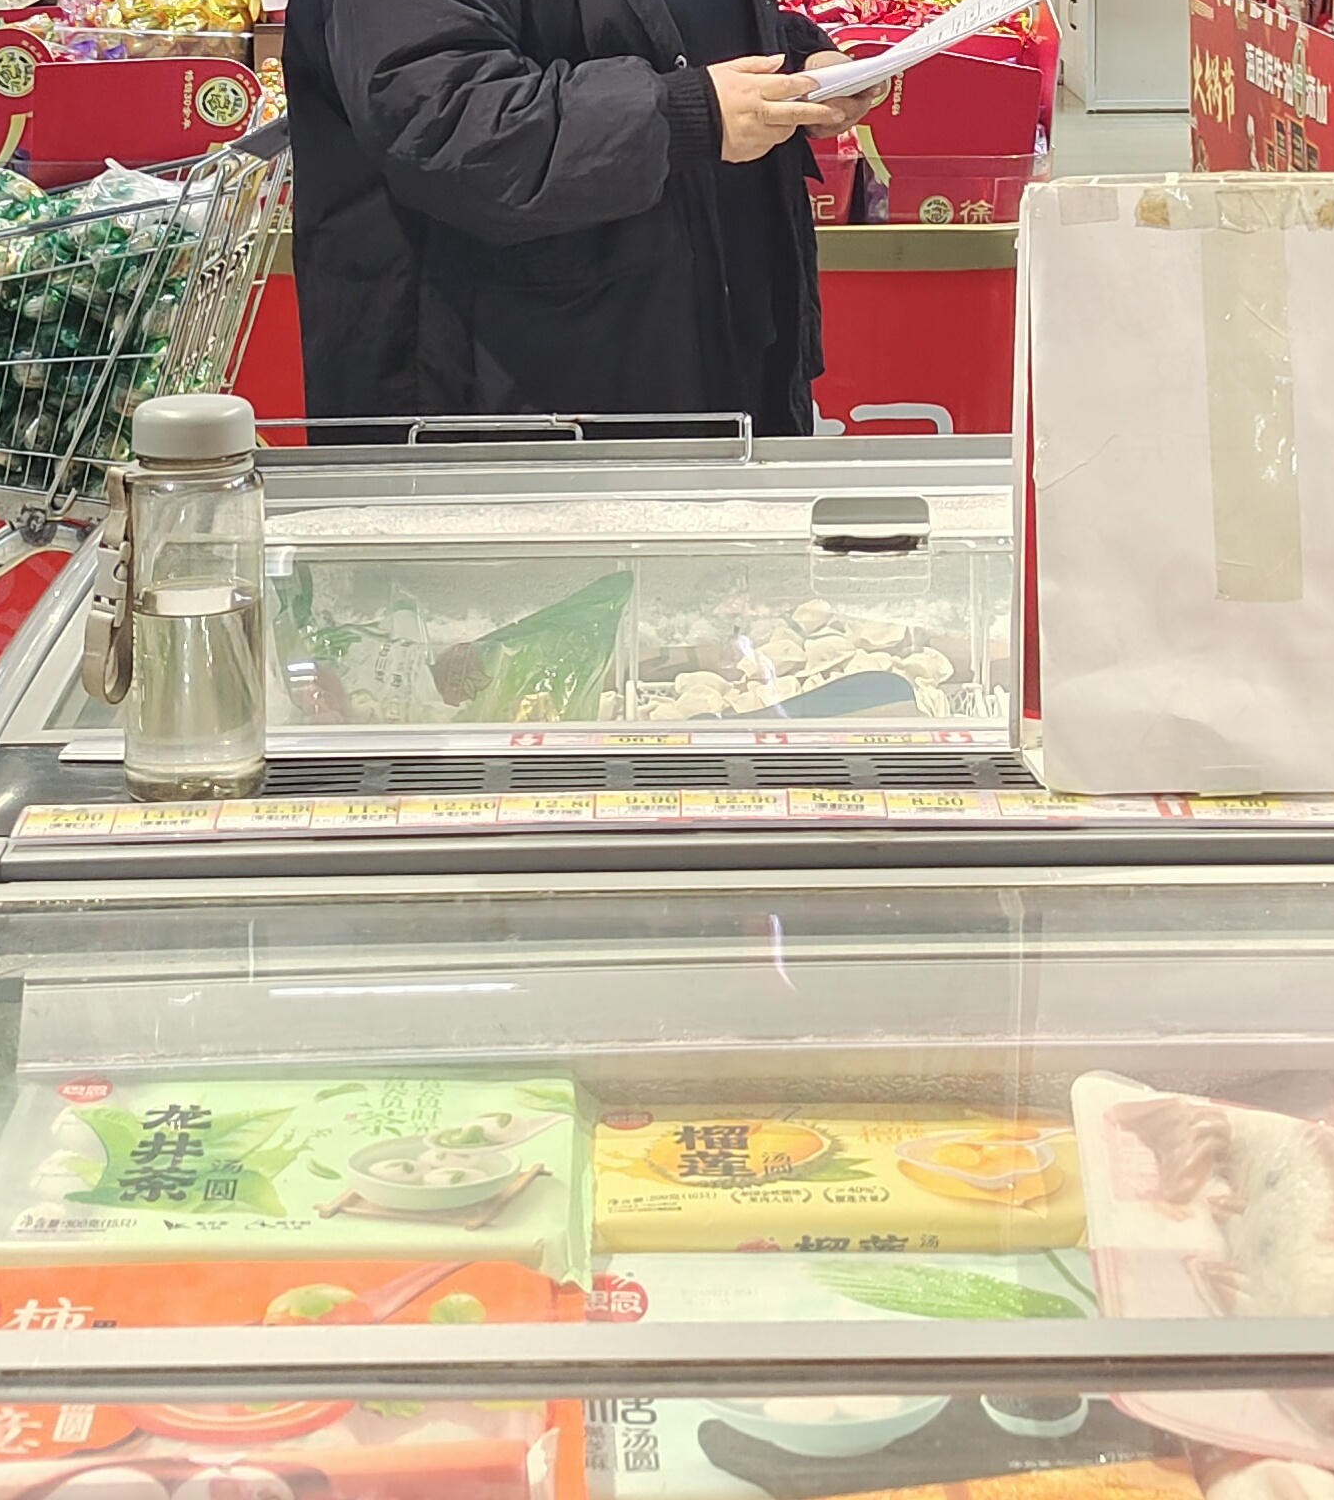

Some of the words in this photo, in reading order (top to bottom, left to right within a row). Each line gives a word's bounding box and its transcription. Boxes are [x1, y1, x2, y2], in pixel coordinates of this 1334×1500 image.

[1192, 43, 1236, 134] 火锅节
[960, 198, 995, 223] 徐
[117, 1104, 213, 1203] 龙井茶
[674, 1124, 757, 1179] 榴莲
[622, 1427, 660, 1473] 汤圆
